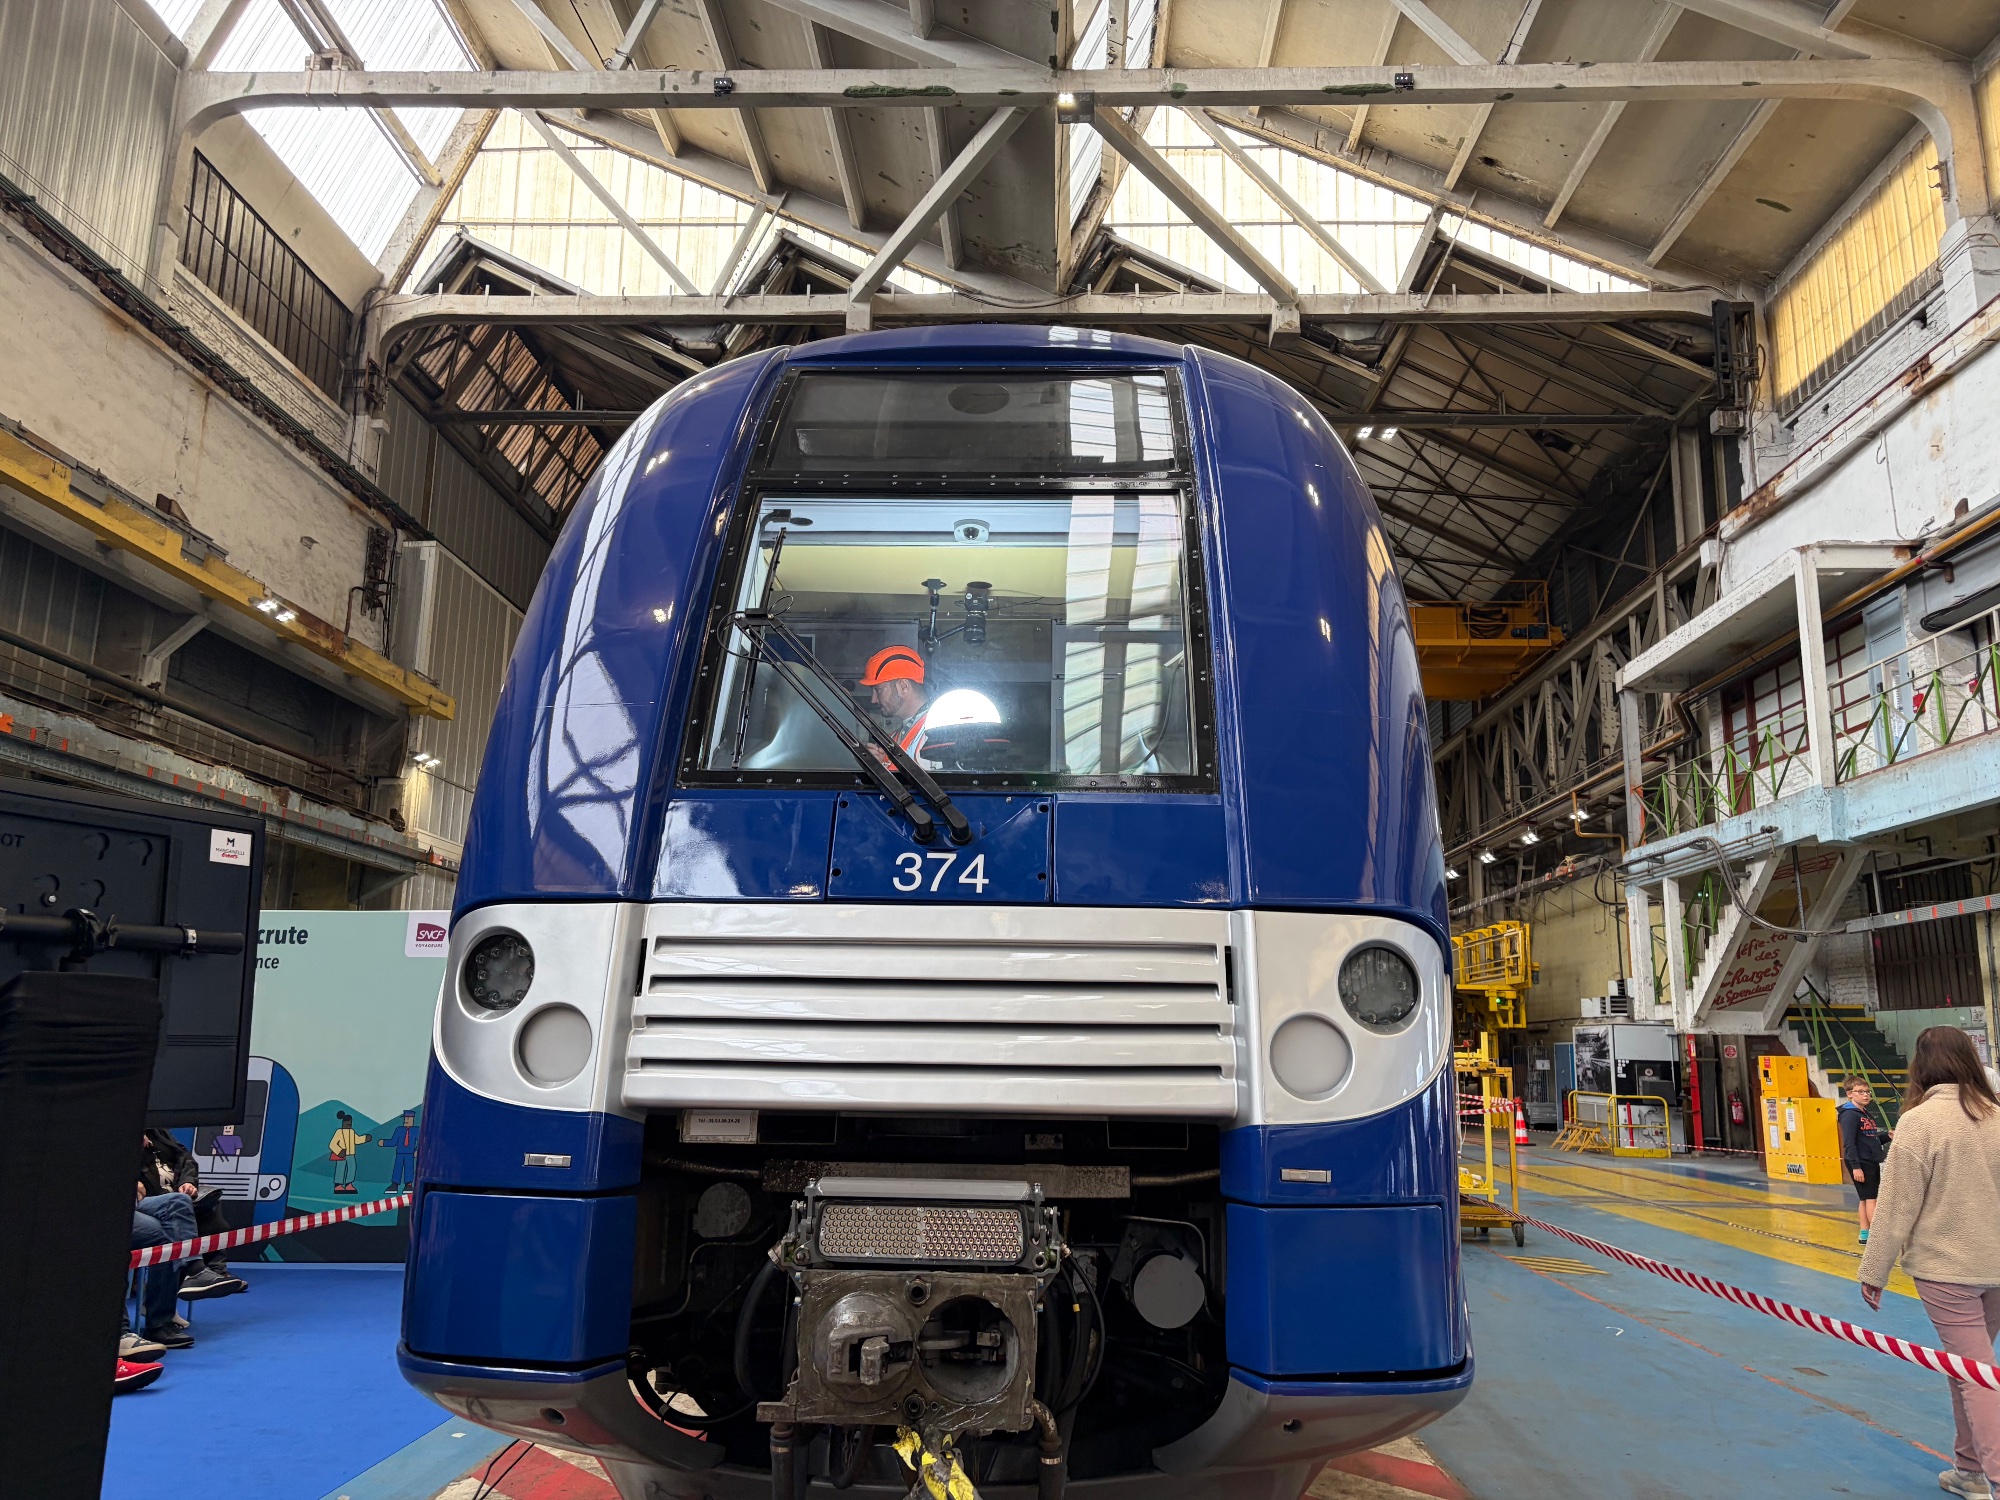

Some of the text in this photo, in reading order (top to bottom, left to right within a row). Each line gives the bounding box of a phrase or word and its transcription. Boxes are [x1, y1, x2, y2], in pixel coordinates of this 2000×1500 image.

[892, 852, 989, 894] 374
[417, 930, 445, 940] SNCF
[1754, 948, 1781, 962] des
